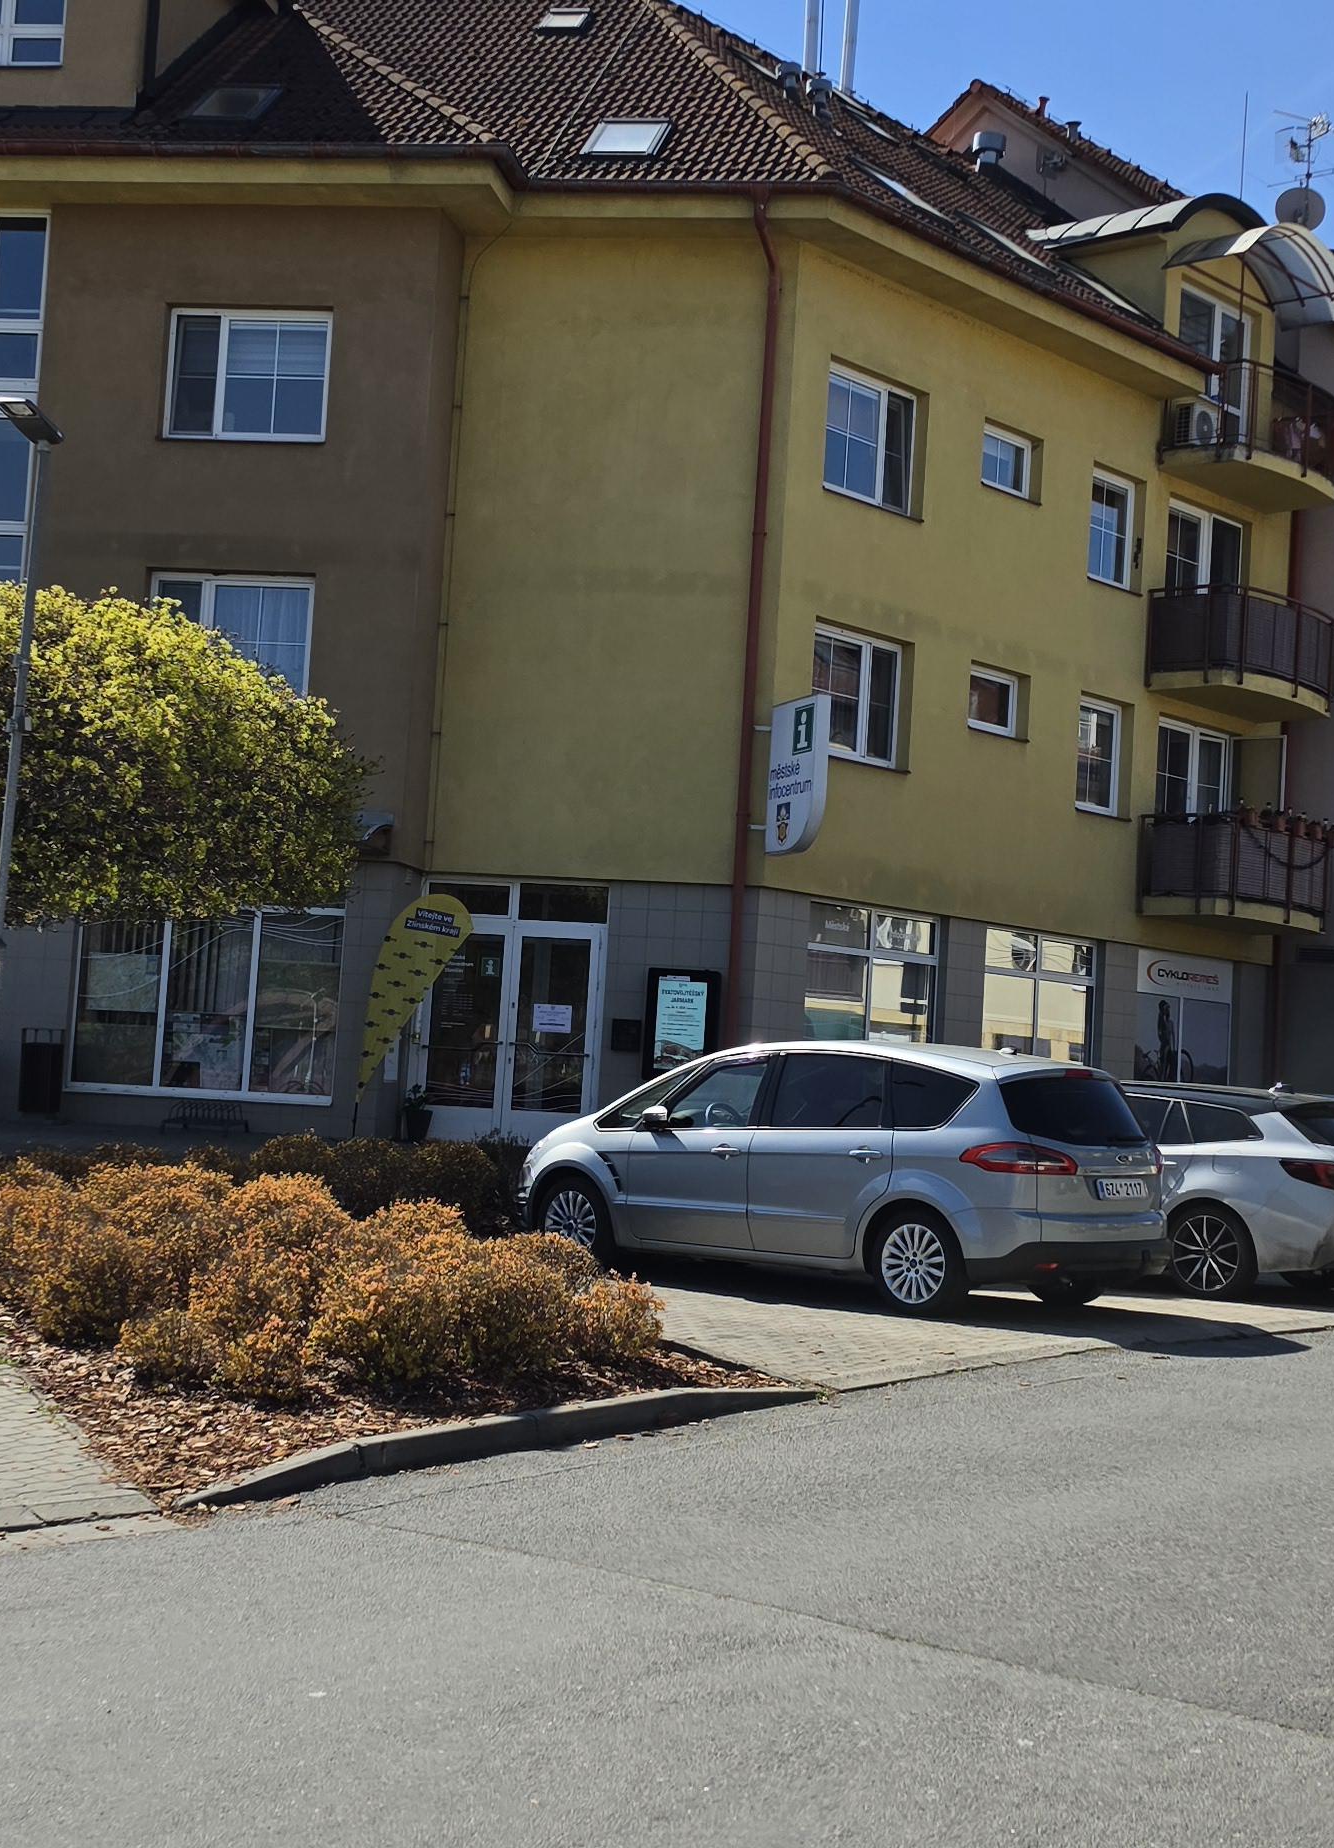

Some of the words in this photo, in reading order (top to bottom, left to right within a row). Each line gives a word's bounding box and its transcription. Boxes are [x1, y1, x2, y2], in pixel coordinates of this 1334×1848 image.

[770, 758, 800, 780] městské
[769, 779, 812, 801] infocentrum
[443, 914, 453, 923] ve
[441, 926, 459, 936] kraji
